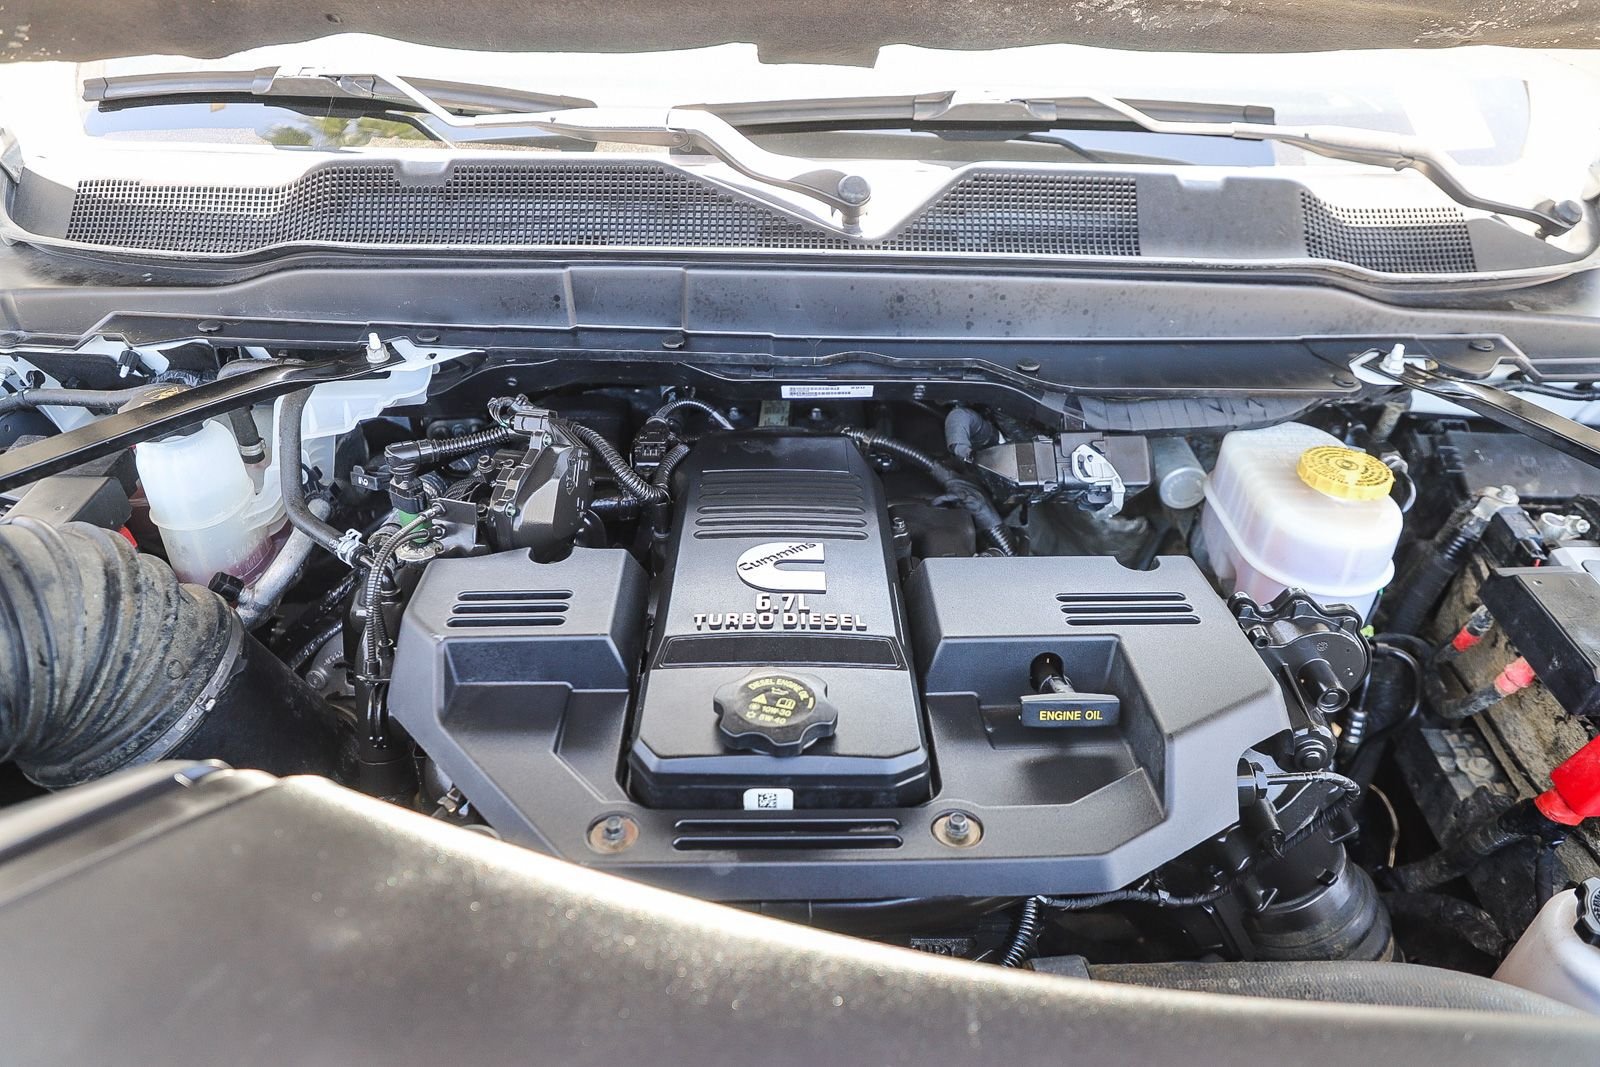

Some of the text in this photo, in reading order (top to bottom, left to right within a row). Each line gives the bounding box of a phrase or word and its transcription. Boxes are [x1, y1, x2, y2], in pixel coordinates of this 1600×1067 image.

[738, 542, 817, 571] Cummins
[755, 593, 810, 614] 6.7L
[694, 612, 868, 631] TURBO DIESEL
[747, 678, 809, 701] DIESEL ENGINE OIL
[761, 705, 792, 717] 10W-30
[1039, 710, 1103, 721] ENGINE OIL
